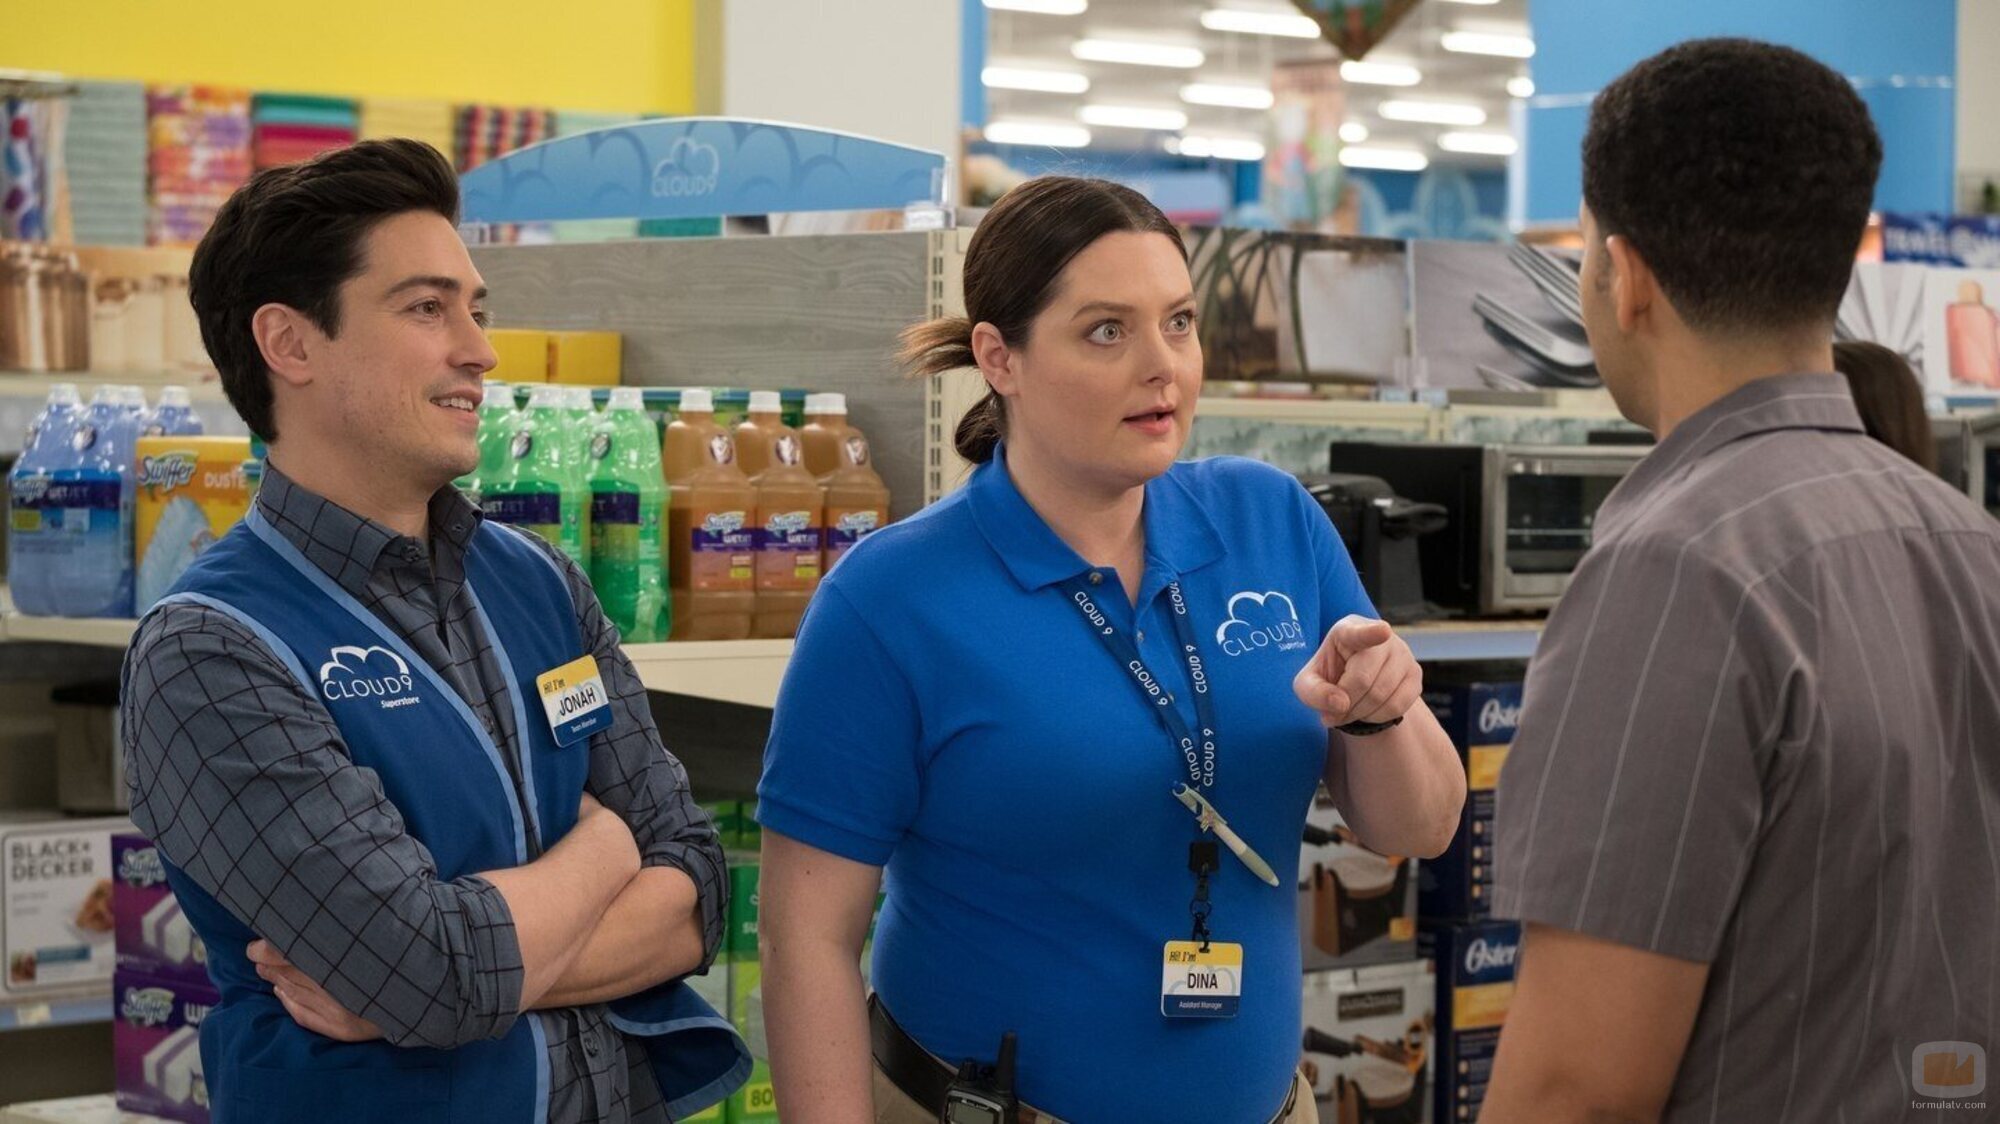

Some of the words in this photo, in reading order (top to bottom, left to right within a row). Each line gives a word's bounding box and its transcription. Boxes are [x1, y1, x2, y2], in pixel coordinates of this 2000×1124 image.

[652, 175, 717, 197] CLOUD9
[138, 454, 196, 492] Swiffer
[204, 472, 248, 488] DUSTE
[1074, 591, 1105, 627] CLOUD
[1102, 627, 1113, 635] 9
[1185, 644, 1197, 653] 9
[1223, 621, 1303, 656] CLOUD9
[324, 675, 412, 700] CLOUD9
[1128, 660, 1161, 696] CLOUD
[1157, 697, 1168, 706] 9
[1189, 655, 1208, 694] CLOUD
[381, 696, 420, 709] Superstore
[559, 687, 597, 716] JONAH
[1479, 699, 1522, 733] Oste
[1203, 728, 1215, 737] 9
[1181, 737, 1201, 781] CLOUD
[1203, 741, 1215, 787] CLOUD
[12, 857, 93, 881] DECKER
[1187, 973, 1218, 989] DINA
